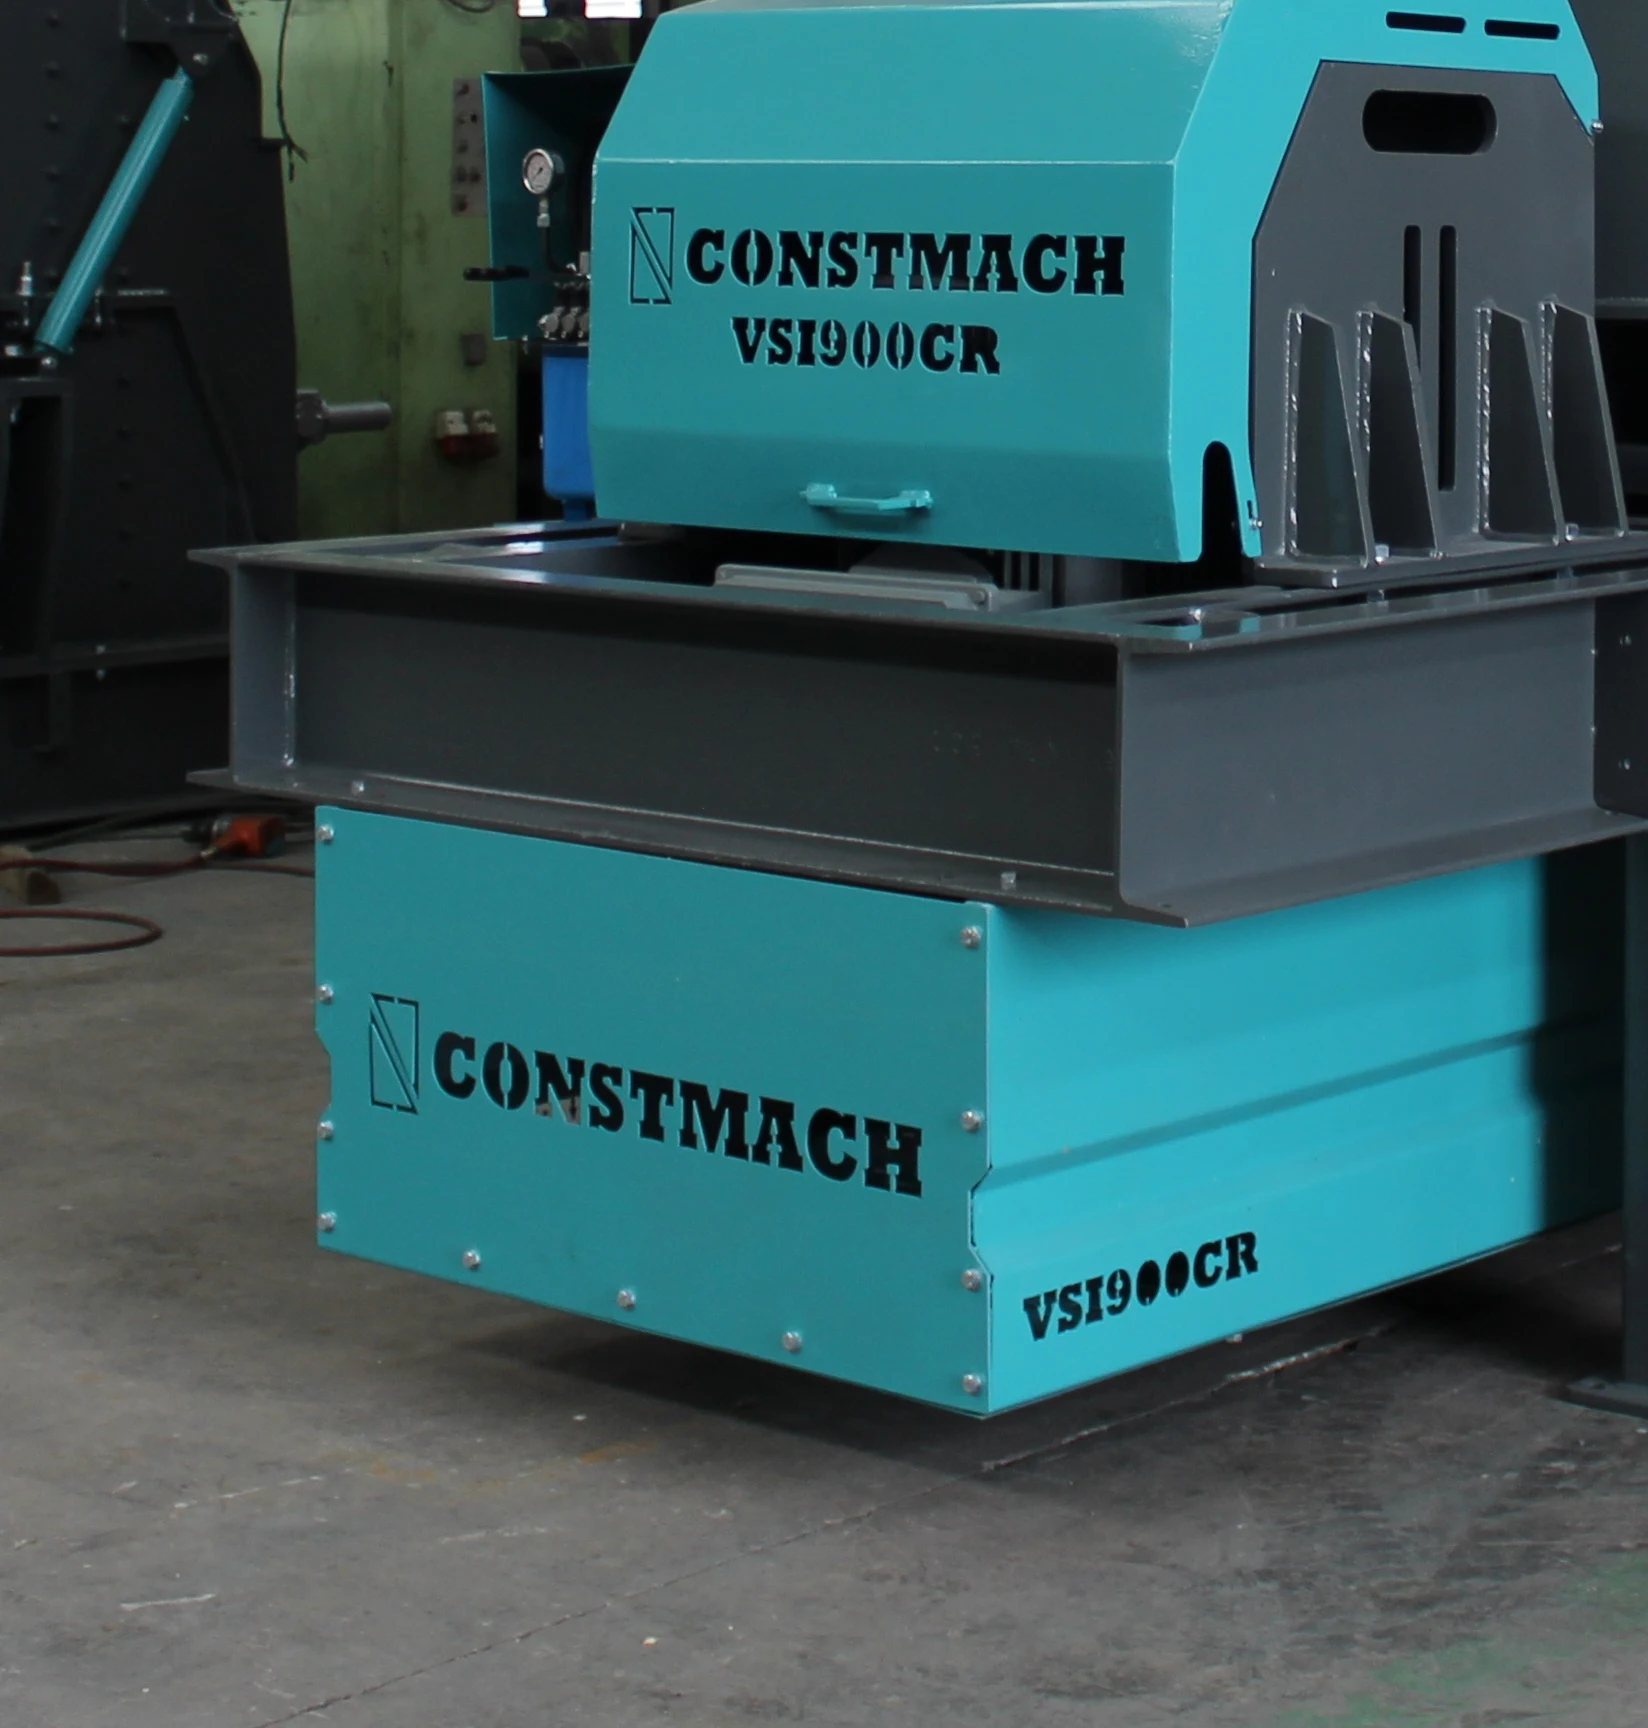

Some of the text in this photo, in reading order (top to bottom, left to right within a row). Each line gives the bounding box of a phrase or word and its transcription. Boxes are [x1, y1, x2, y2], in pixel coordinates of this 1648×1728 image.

[685, 228, 1126, 296] CONSTMACH
[731, 316, 1000, 375] VSI900CR
[433, 1030, 923, 1198] CONSTMACH
[1022, 1231, 1258, 1341] VSI900CR
